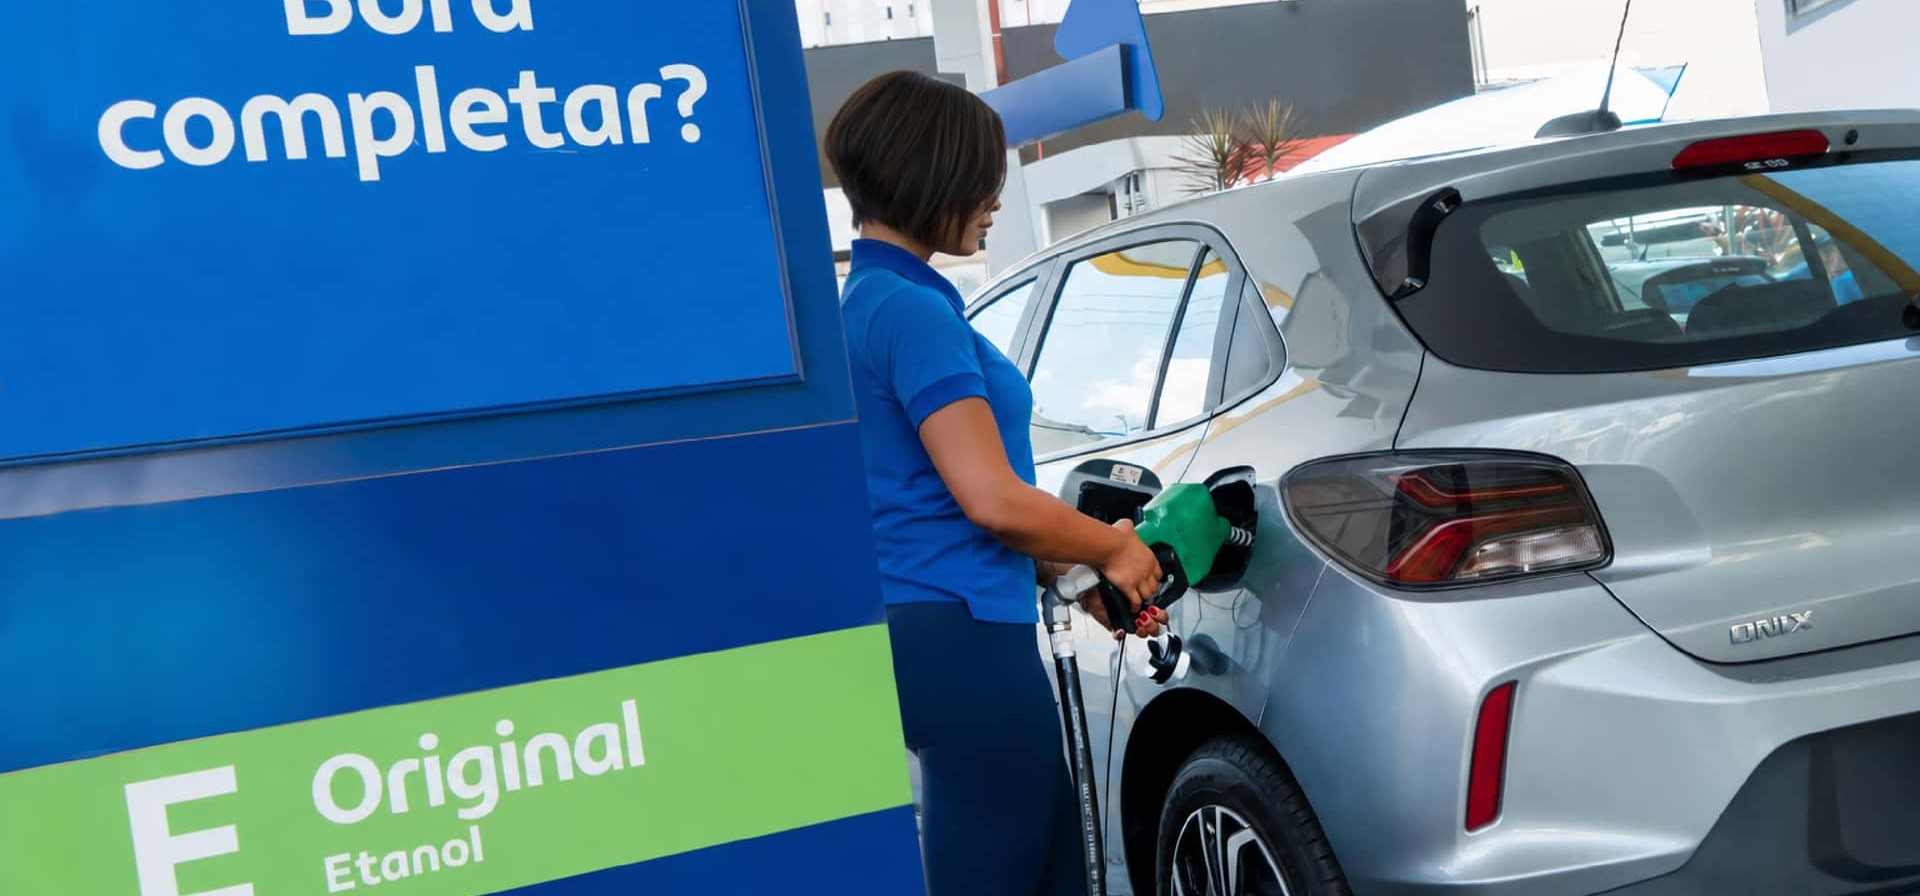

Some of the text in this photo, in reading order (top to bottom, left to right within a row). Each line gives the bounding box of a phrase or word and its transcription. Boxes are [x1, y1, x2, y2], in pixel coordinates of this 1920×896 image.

[97, 63, 709, 183] completar?
[1729, 609, 1813, 645] ONIX
[311, 698, 646, 825] Original
[123, 763, 256, 896] E
[323, 824, 485, 894] Etanol
